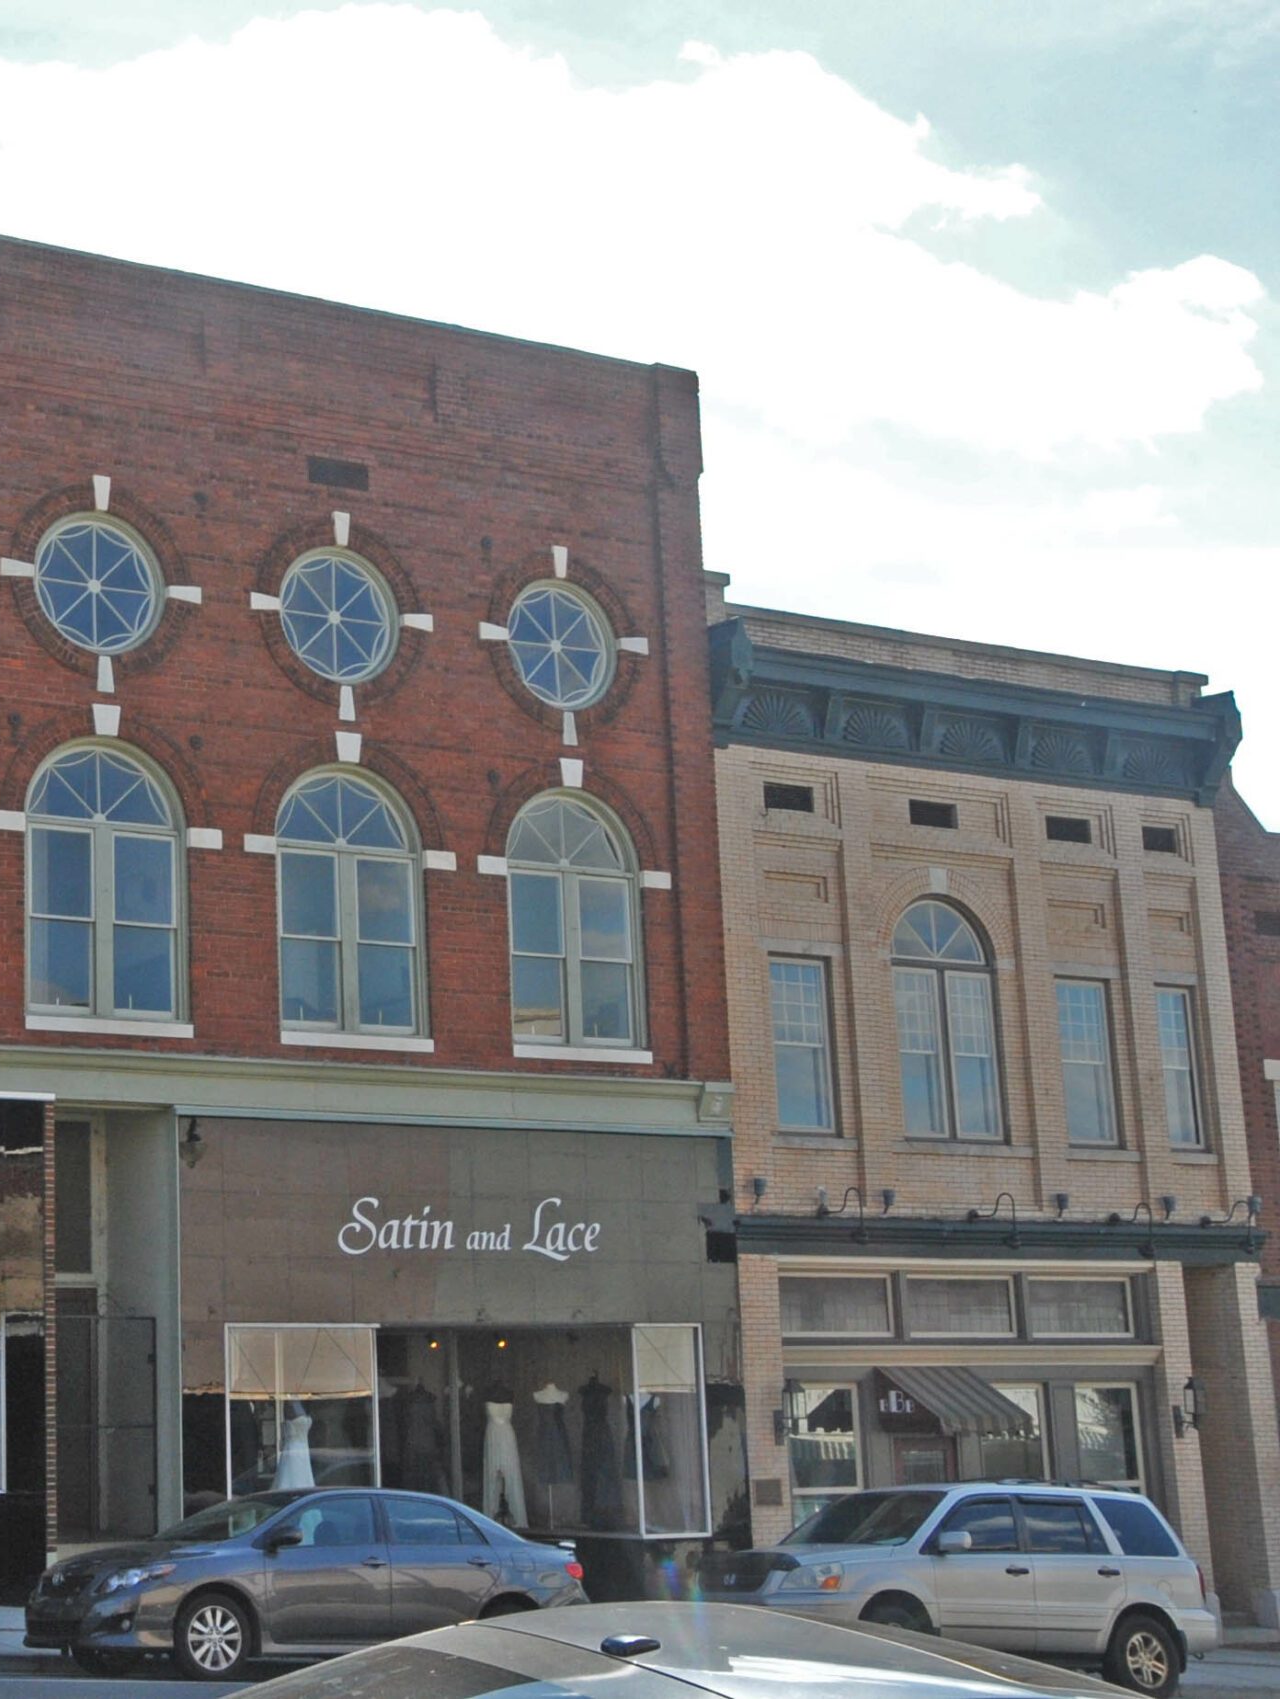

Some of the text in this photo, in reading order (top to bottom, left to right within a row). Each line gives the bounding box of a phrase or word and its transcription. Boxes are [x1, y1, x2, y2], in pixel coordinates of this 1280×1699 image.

[338, 1197, 601, 1262] Satin and Lace
